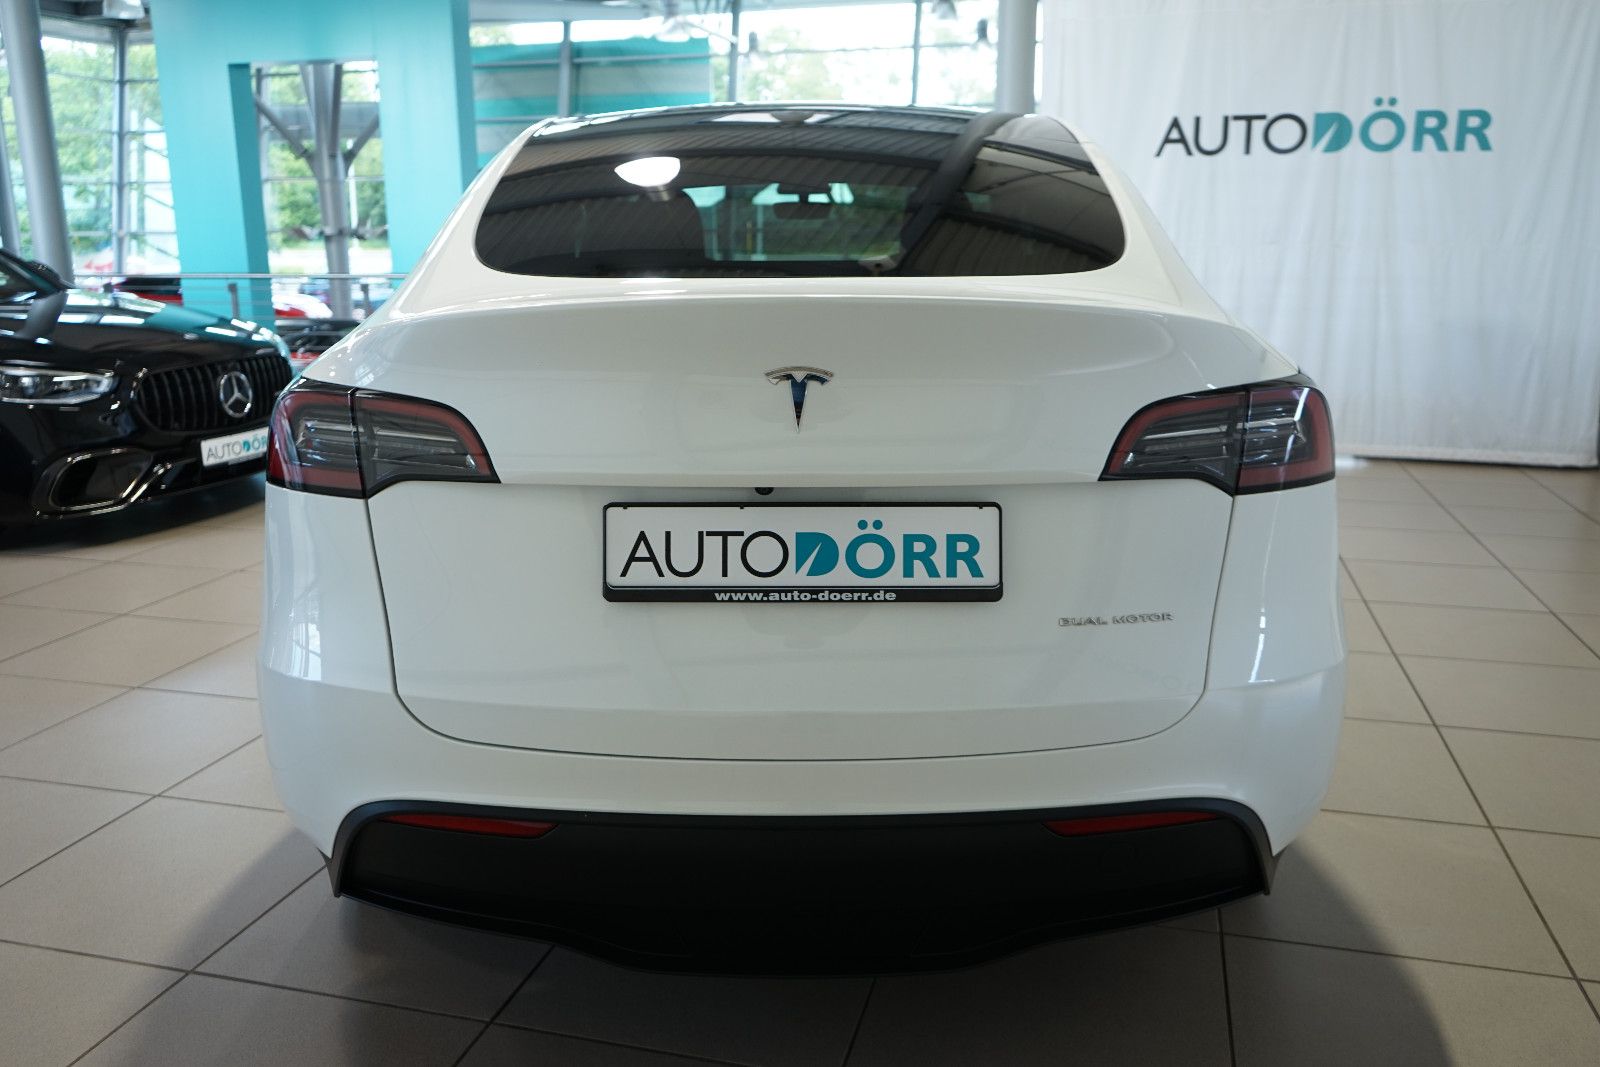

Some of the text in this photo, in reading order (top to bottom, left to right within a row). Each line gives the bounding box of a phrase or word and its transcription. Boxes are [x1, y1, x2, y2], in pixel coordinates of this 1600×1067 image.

[1155, 97, 1493, 157] AUTODÖRR
[206, 434, 267, 461] AUTODÖR
[619, 519, 984, 578] AUTODÖRR
[714, 590, 896, 601] www.auto-doerr.de
[1112, 612, 1174, 625] MOTOR
